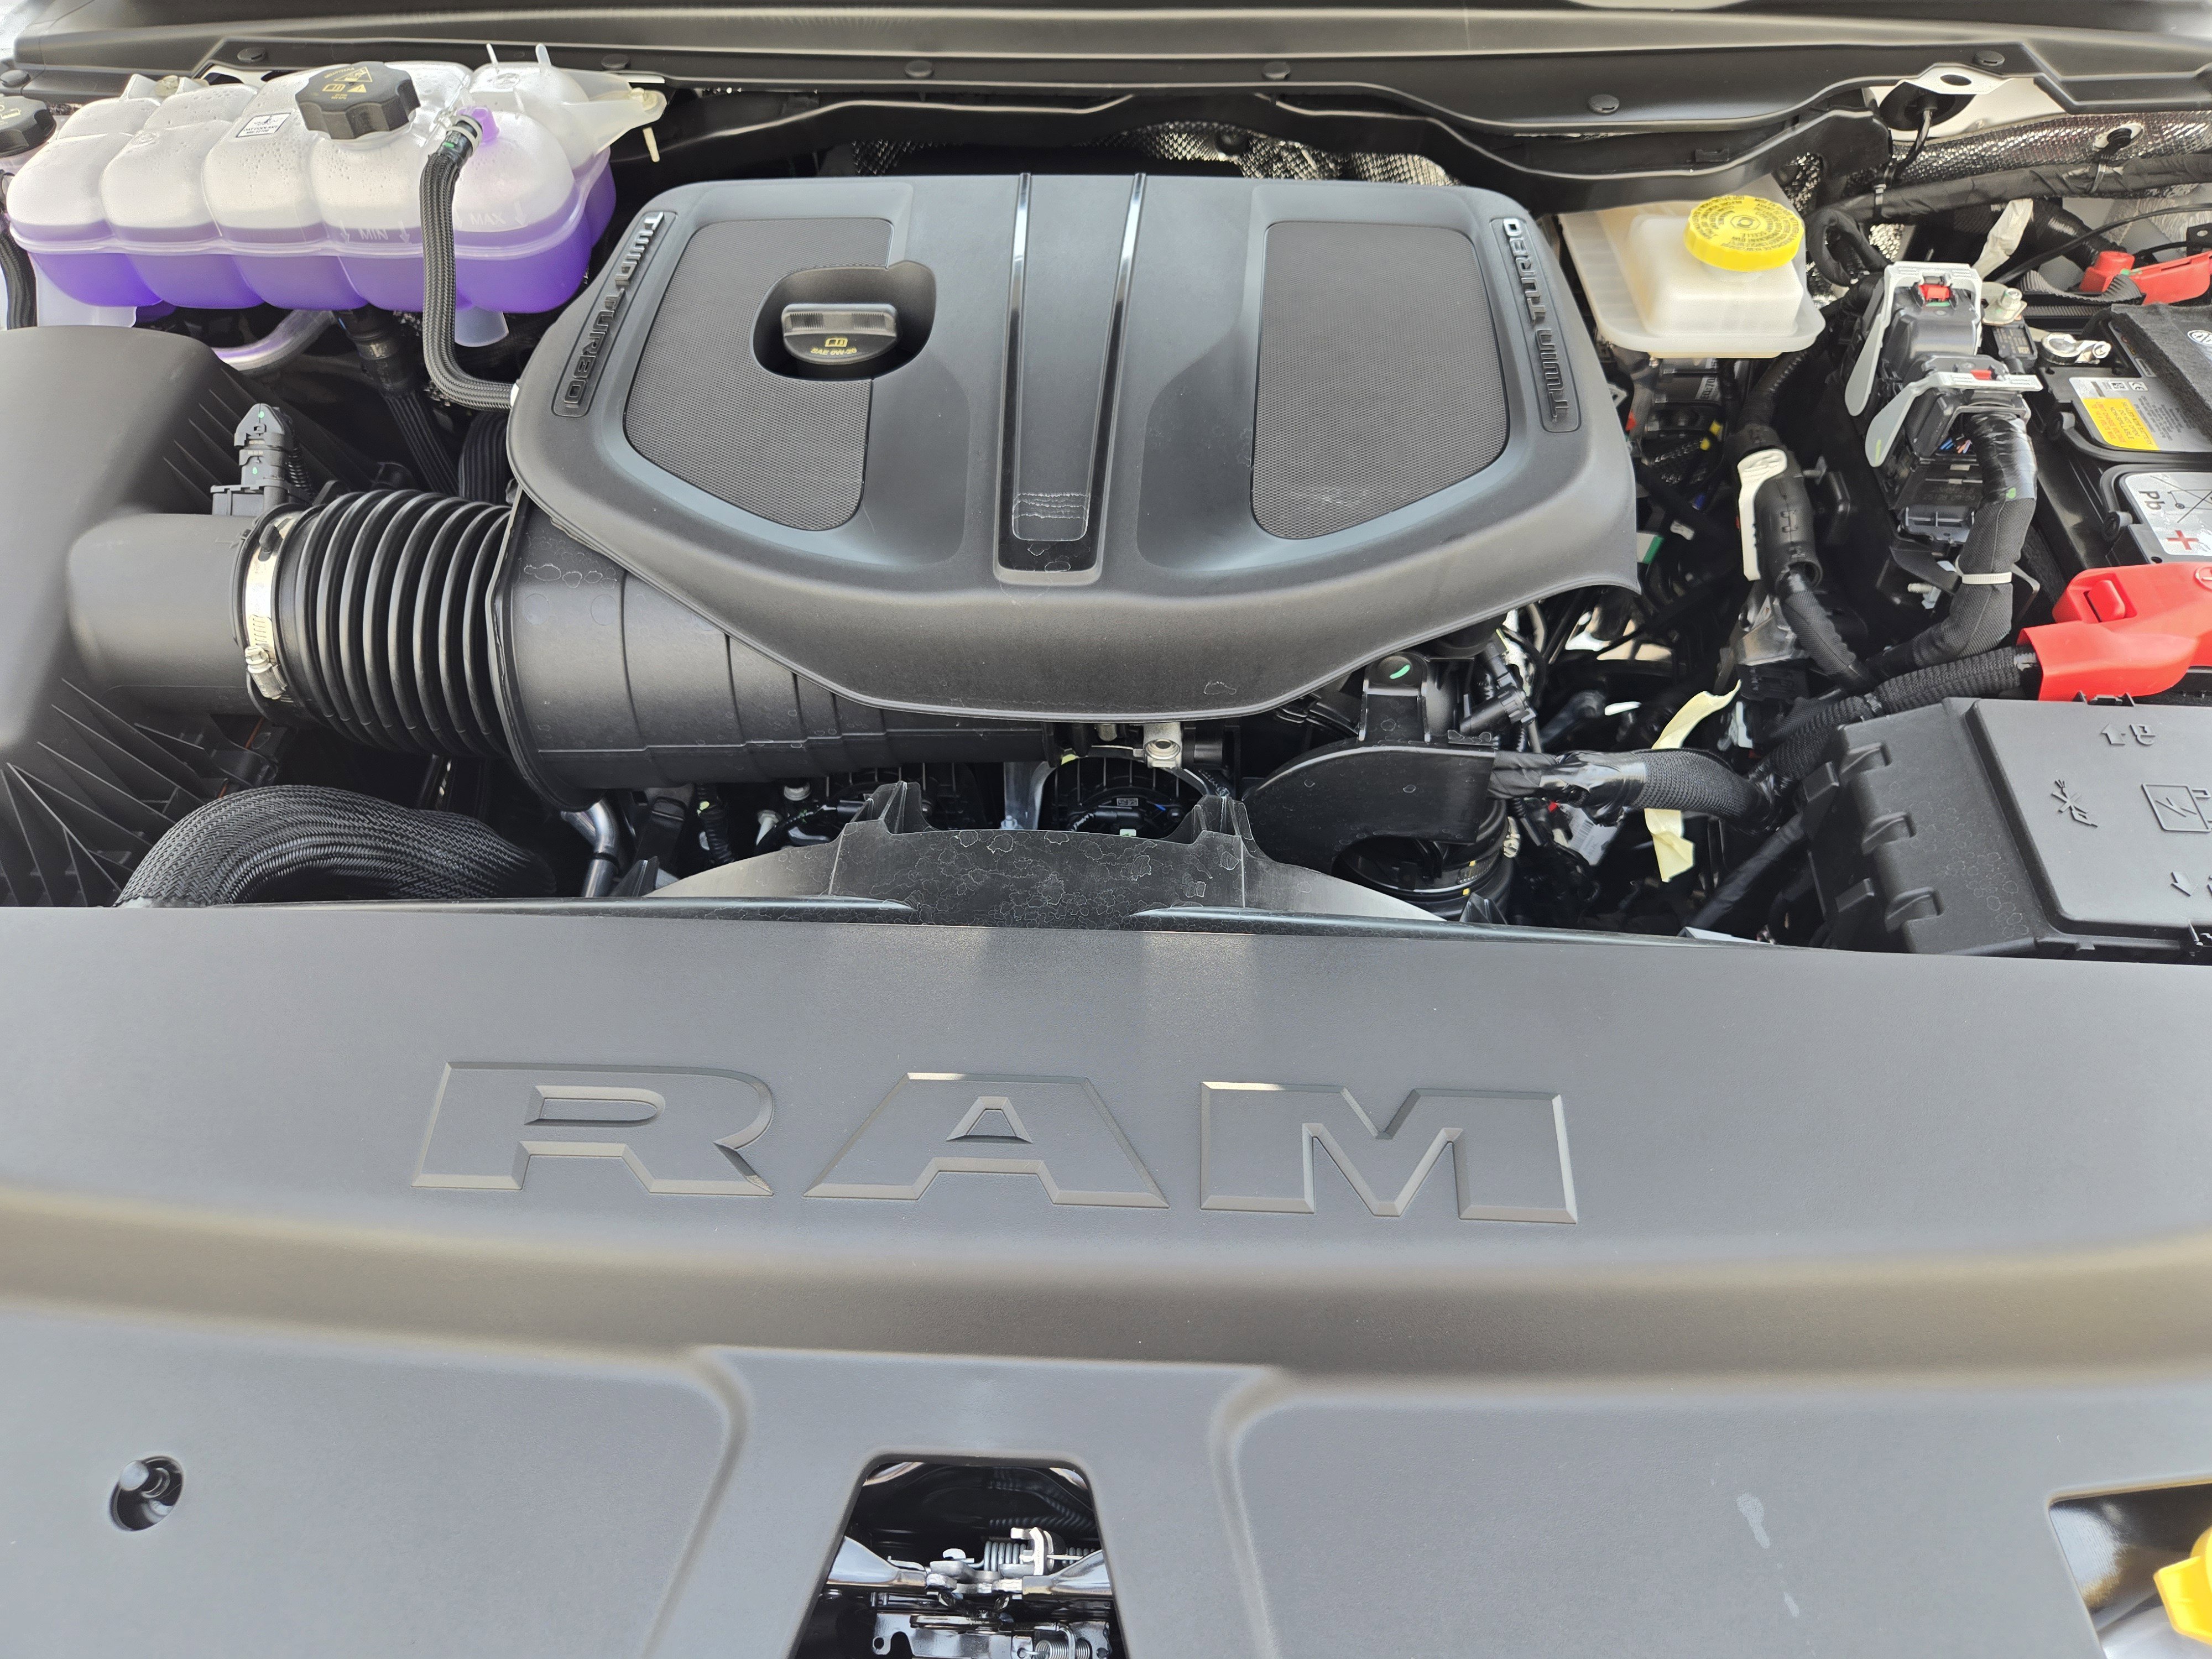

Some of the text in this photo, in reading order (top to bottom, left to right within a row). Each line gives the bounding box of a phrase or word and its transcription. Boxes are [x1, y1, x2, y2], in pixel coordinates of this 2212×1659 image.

[469, 213, 507, 226] MAX
[359, 228, 389, 241] MIN
[563, 211, 664, 408] TWIN TURBO
[1503, 217, 1570, 422] TWIN TURBO
[811, 347, 857, 356] SAE 0W-20
[2137, 491, 2166, 510] Pb
[410, 1061, 1578, 1224] RAM
